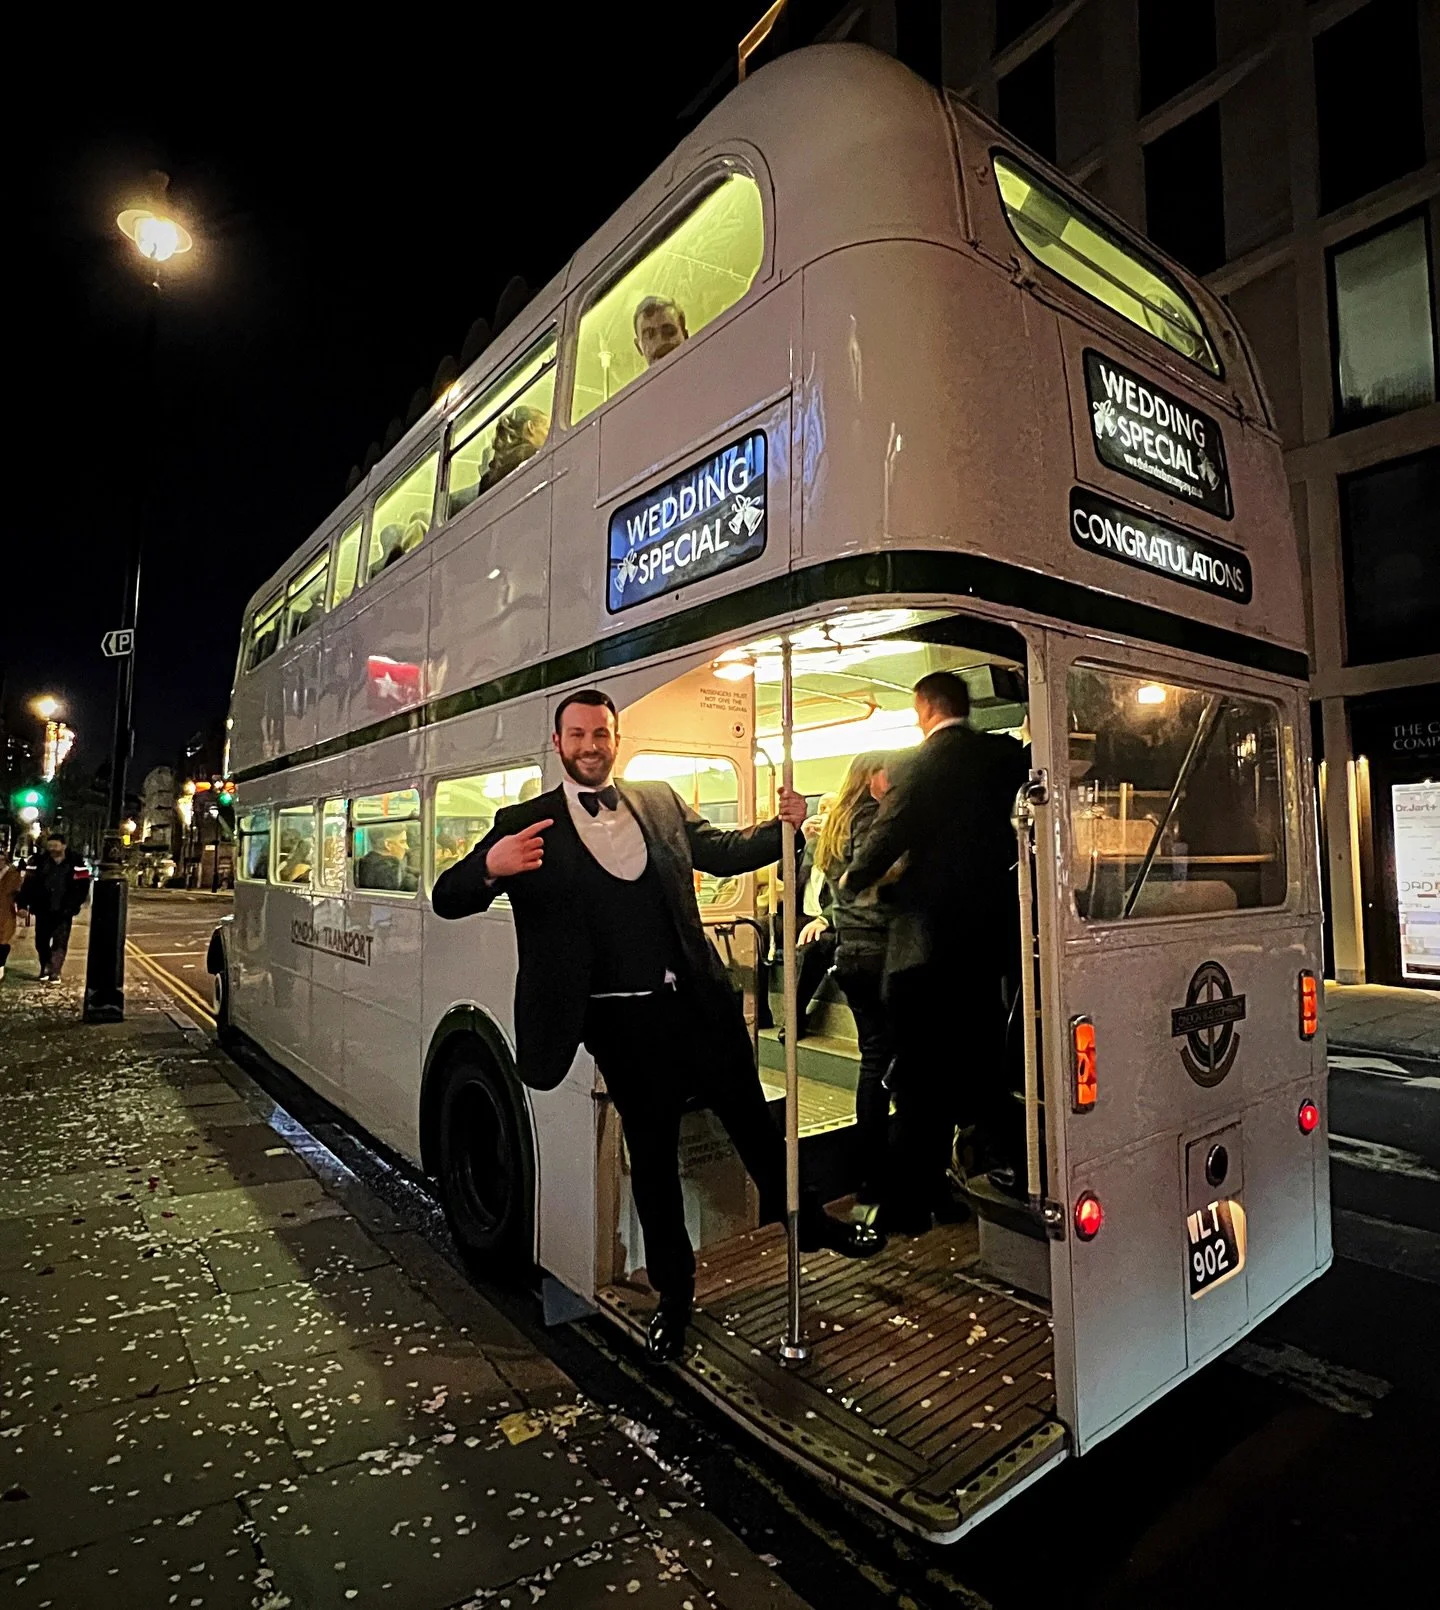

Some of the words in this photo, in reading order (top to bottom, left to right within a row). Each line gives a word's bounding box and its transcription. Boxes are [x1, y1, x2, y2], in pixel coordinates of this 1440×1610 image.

[1099, 364, 1206, 449] WEDDING
[1117, 415, 1200, 481] SPECIAL
[626, 456, 749, 546] WEDDING
[638, 518, 730, 585] SPECIAL
[1073, 508, 1245, 593] CONGRATULATIONS
[119, 633, 130, 651] P
[1393, 722, 1424, 738] THE
[1193, 1238, 1229, 1283] 902
